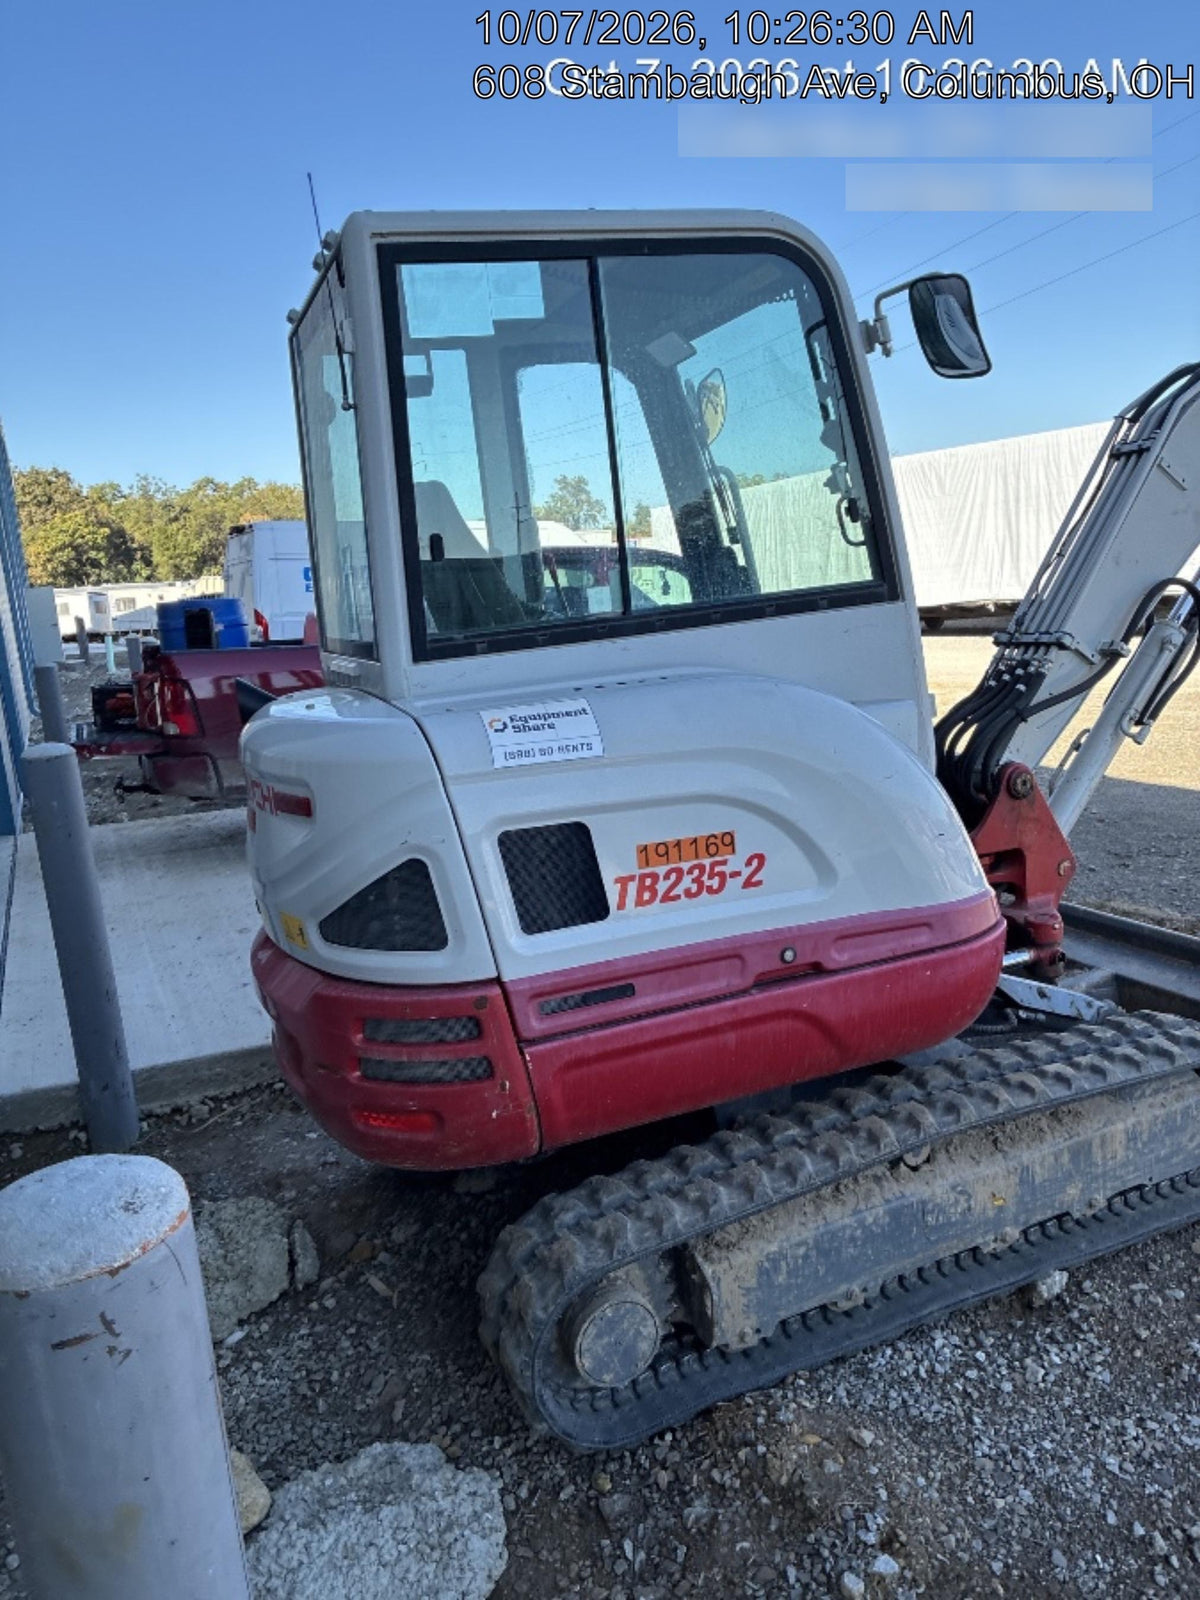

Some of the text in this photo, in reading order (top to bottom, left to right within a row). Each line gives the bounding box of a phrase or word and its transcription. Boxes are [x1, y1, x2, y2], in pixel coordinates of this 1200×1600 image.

[508, 707, 589, 724] Equipment
[511, 721, 556, 733] Share
[638, 831, 736, 868] 191169
[613, 852, 767, 912] TB235-2
